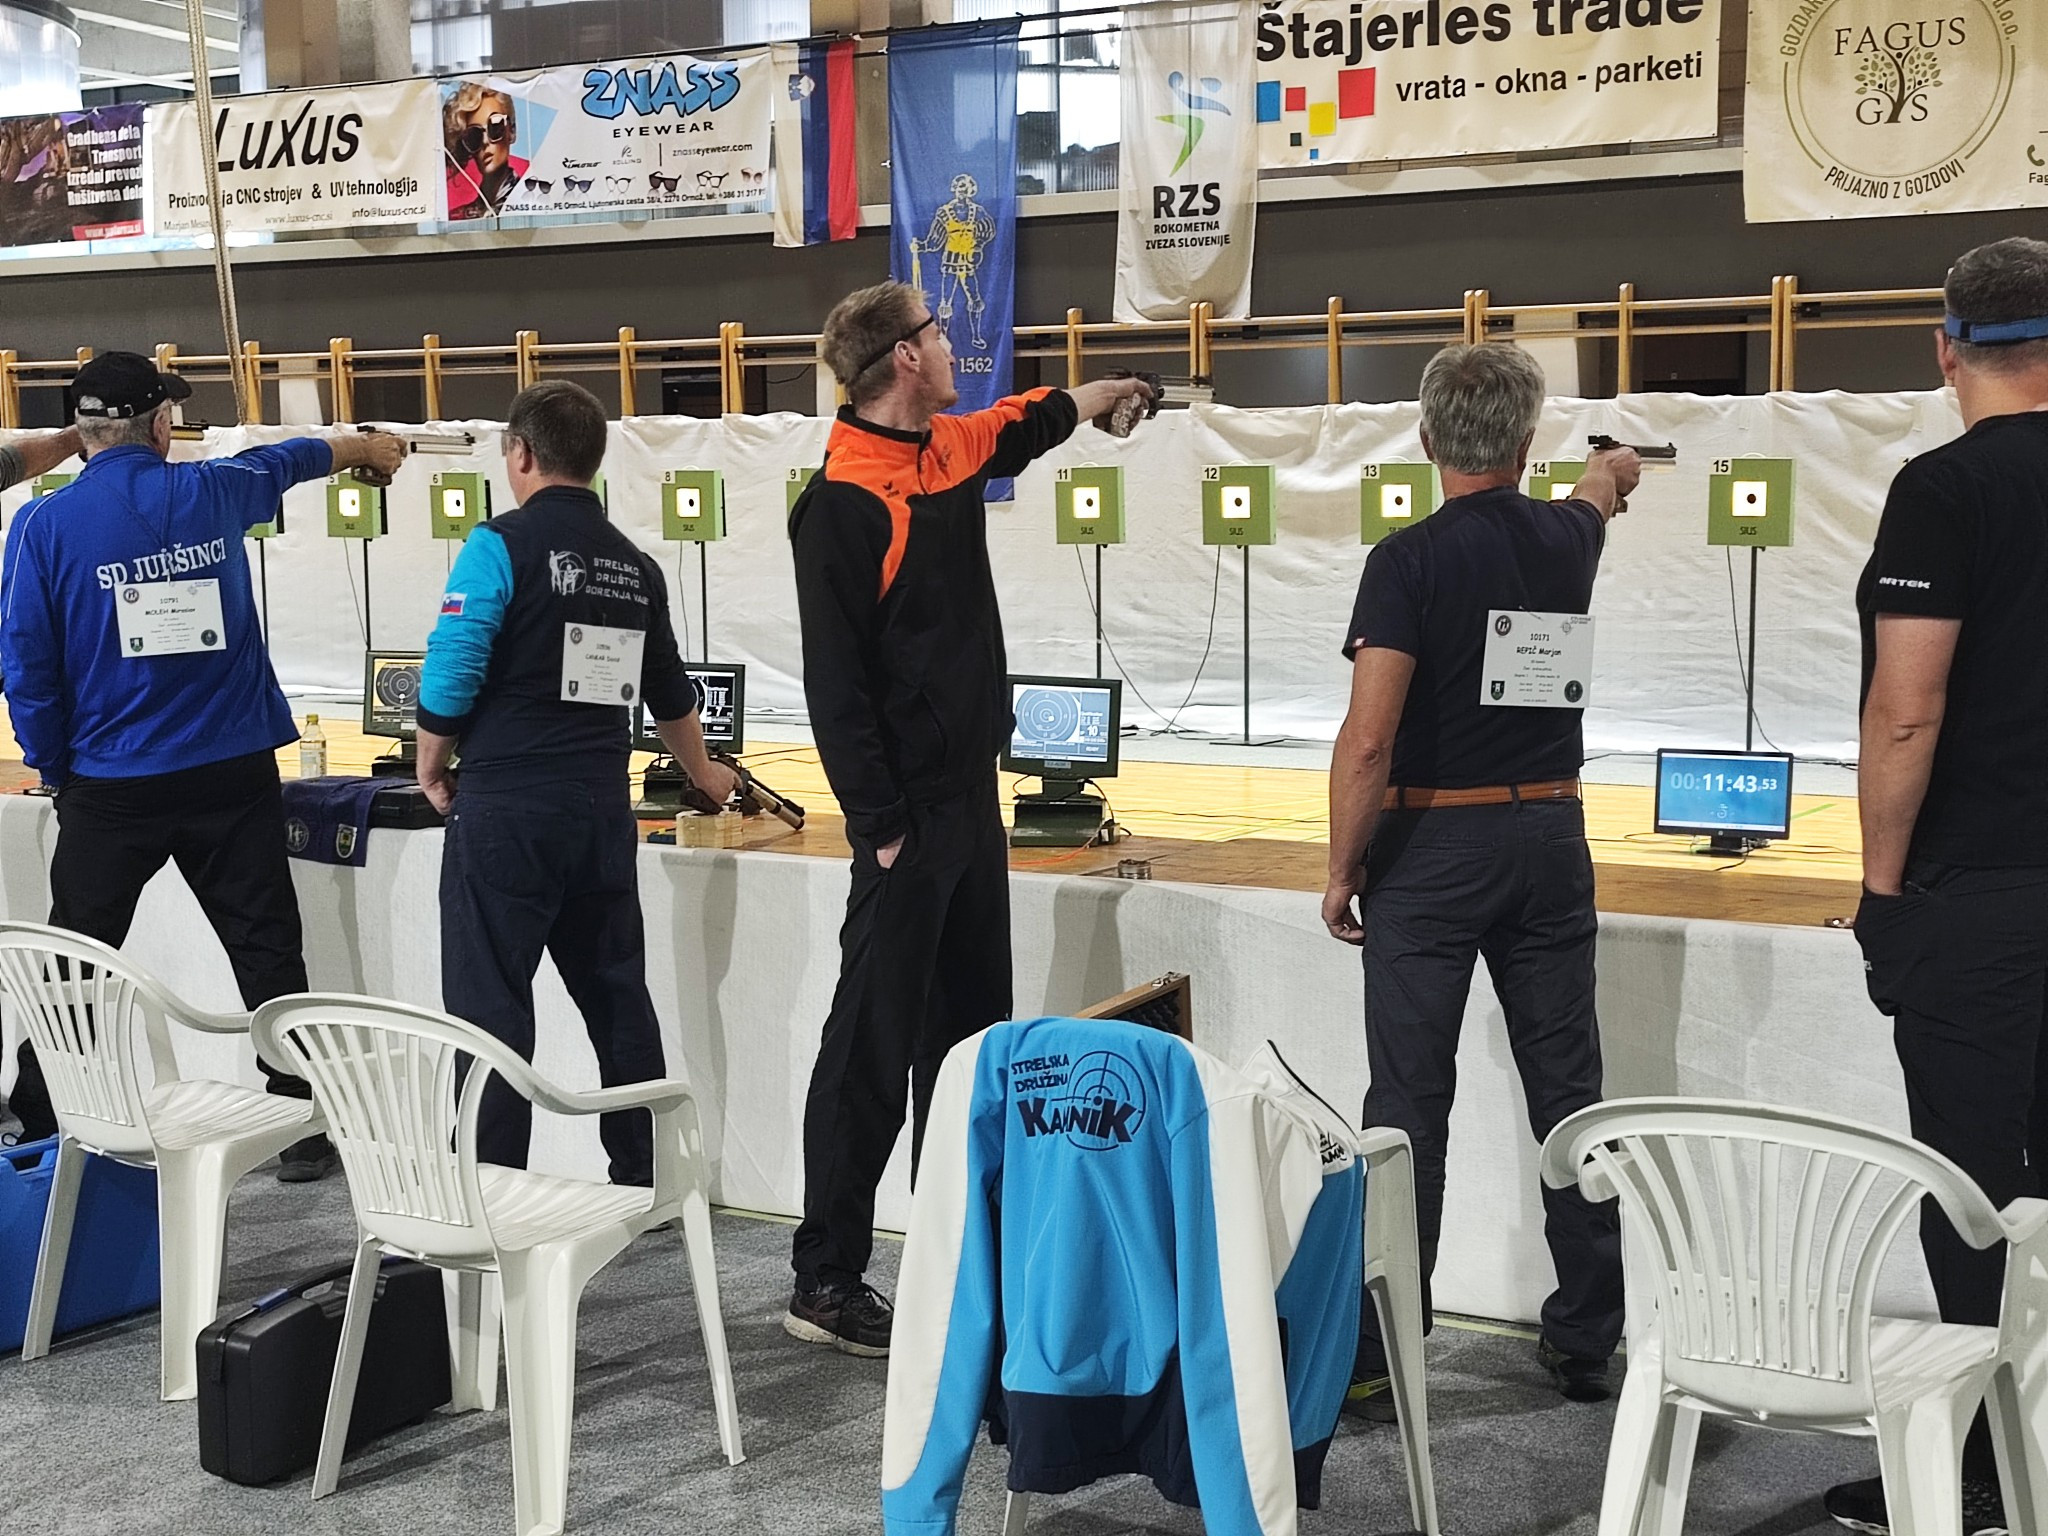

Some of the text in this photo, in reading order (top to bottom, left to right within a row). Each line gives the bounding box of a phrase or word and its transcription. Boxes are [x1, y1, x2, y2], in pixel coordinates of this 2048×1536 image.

[1257, 1, 1512, 66] Štajerles
[1834, 17, 1966, 56] FAGUS
[1395, 74, 1466, 101] vrata
[1494, 68, 1567, 95] okna
[1595, 51, 1702, 92] parketi
[581, 59, 741, 121] ZNASS
[67, 124, 141, 148] Gradbena dela
[613, 121, 714, 138] EYEWEAR
[91, 146, 142, 165] Transport
[672, 143, 753, 157] znasseyewear.com
[66, 169, 105, 187] Izredni
[1824, 158, 1965, 199] PRIJAZNO Z GOZDOVI
[67, 187, 122, 207] Rušitvena
[236, 187, 262, 204] CNC
[263, 185, 303, 205] strojev
[312, 183, 322, 199] &
[330, 181, 346, 198] UV
[346, 177, 418, 198] tehnologija
[505, 204, 530, 212] ZNASS
[1153, 182, 1221, 219] RZS
[352, 205, 427, 218] info@luxus-cnc.si
[1154, 220, 1220, 234] ROKOMETNA
[1145, 234, 1231, 250] ZVEZA SLOVENIJE
[959, 356, 993, 373] 1562
[790, 468, 797, 480] 9
[1057, 469, 1068, 480] 11
[1204, 467, 1218, 479] 12
[1363, 465, 1377, 477] 13
[1531, 463, 1547, 475] 14
[1712, 460, 1729, 473] 15
[432, 474, 438, 484] 6
[665, 471, 671, 482] 8
[96, 562, 128, 590] SD
[1530, 633, 1550, 641] 10171
[1011, 1053, 1070, 1075] STRELSKA
